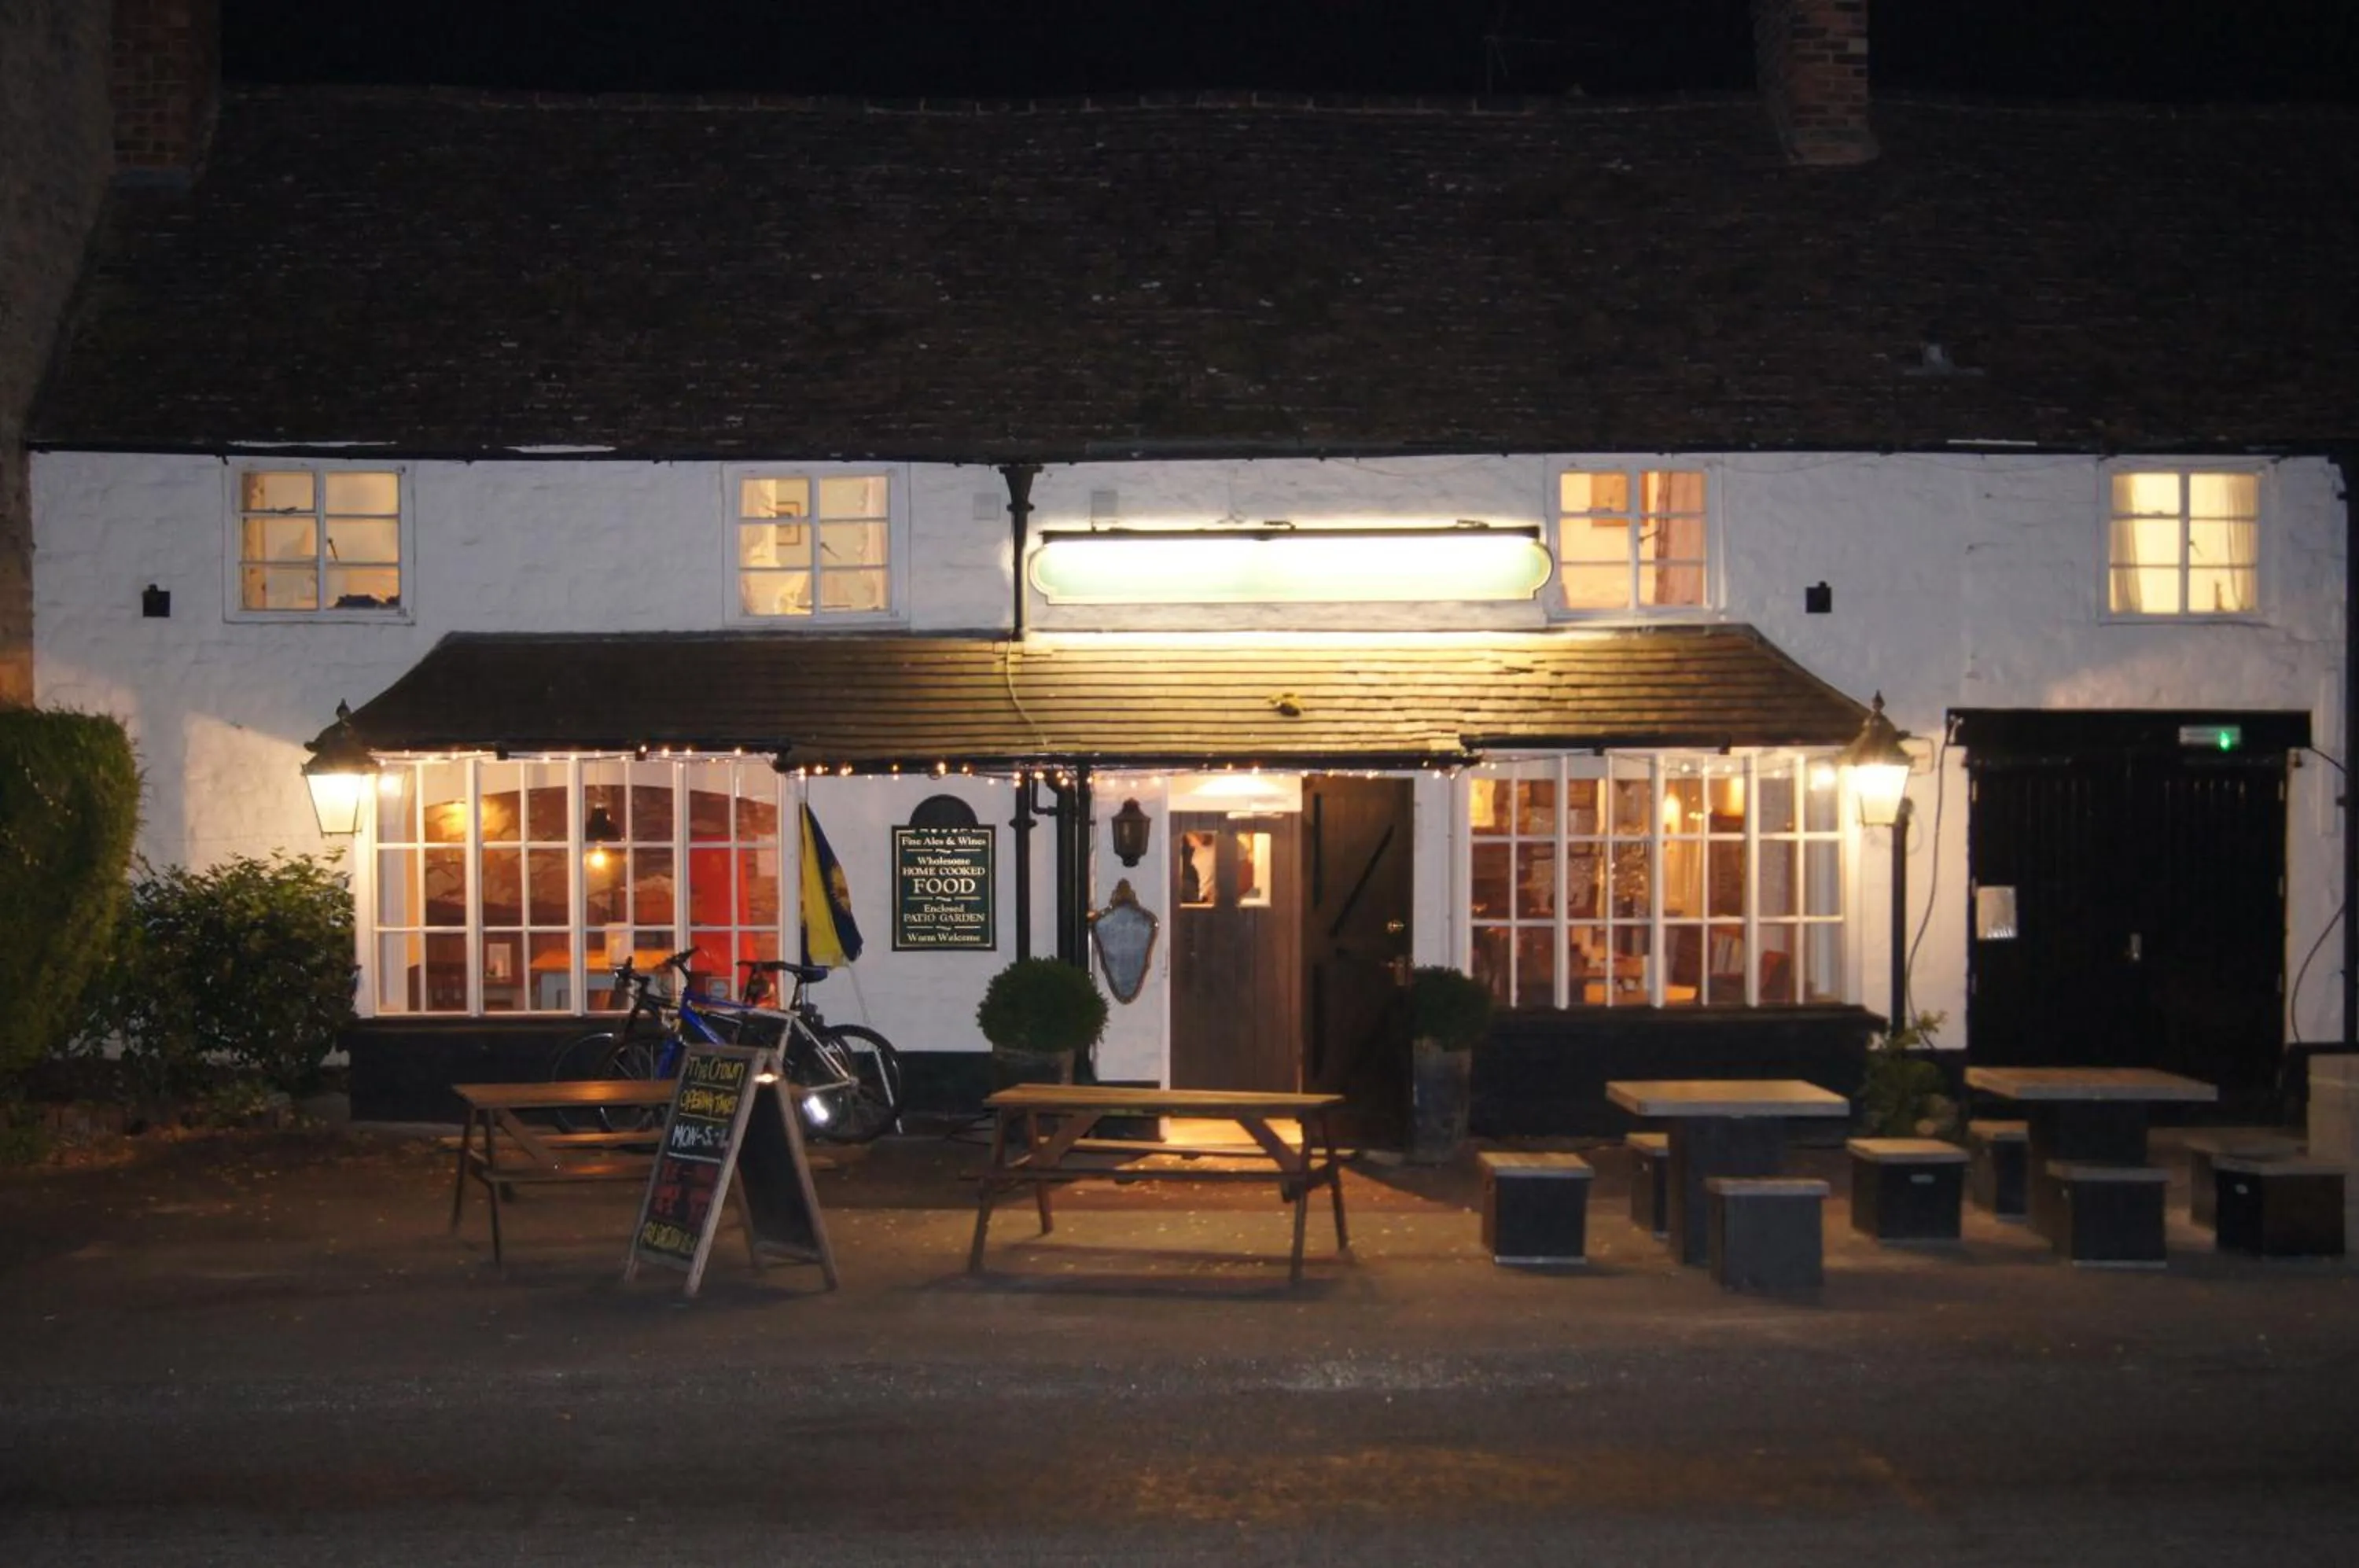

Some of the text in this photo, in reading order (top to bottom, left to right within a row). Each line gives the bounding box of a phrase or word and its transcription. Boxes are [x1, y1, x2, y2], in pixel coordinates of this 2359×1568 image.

[902, 836, 987, 845] Fine Ales & Wines
[918, 856, 970, 866] Wholesome
[903, 867, 985, 875] HOME COOKED
[913, 878, 976, 894] FOOD
[924, 904, 965, 913] Enclosed
[903, 913, 985, 922] PATIO GARDEN
[907, 933, 981, 941] Warm Welcome
